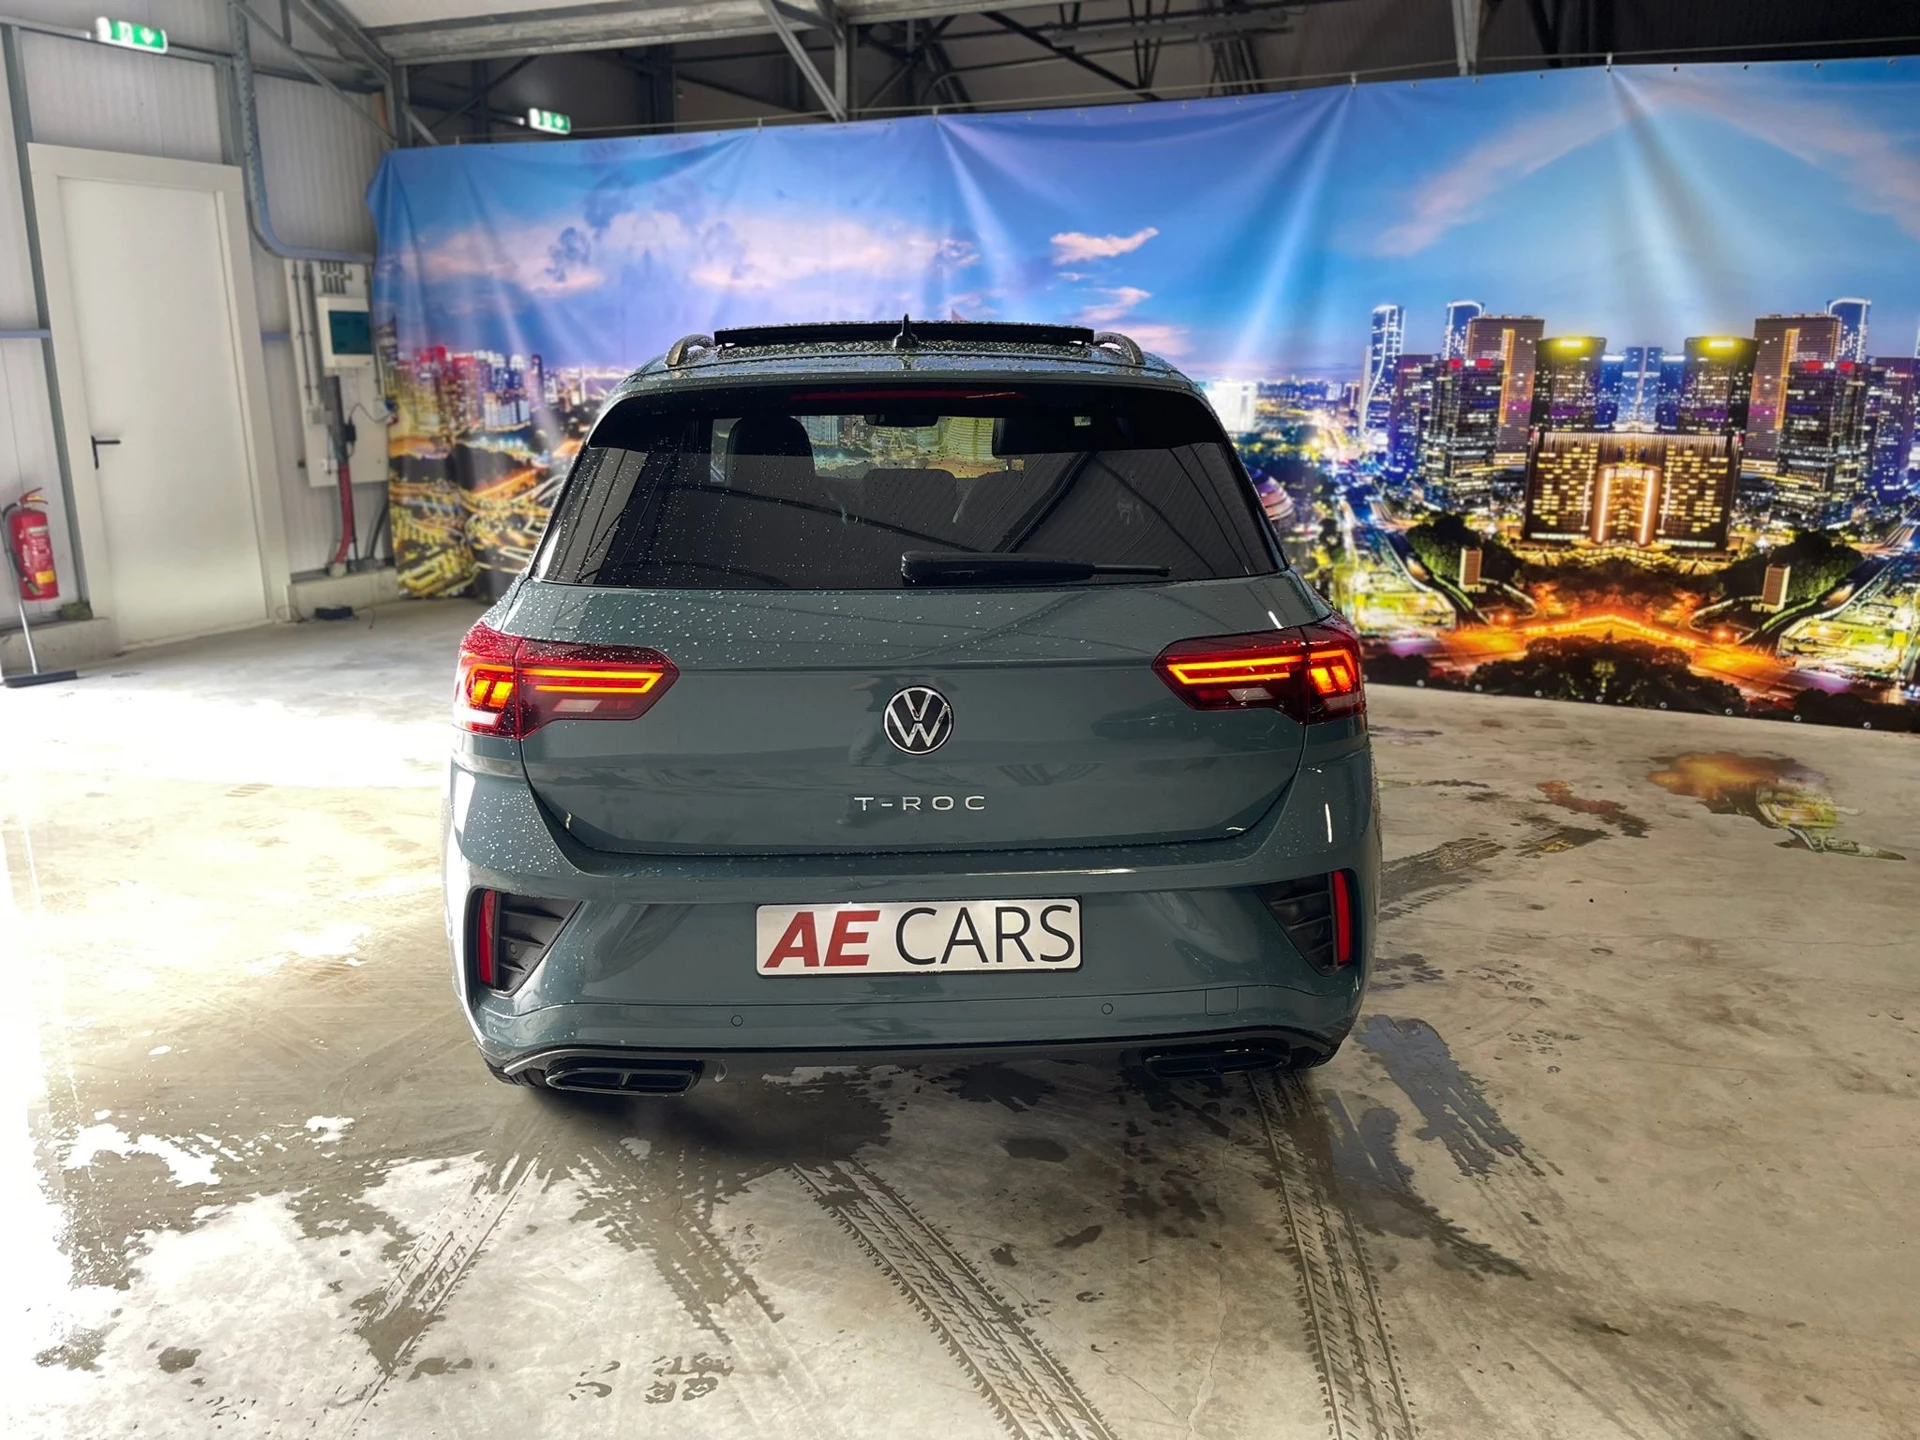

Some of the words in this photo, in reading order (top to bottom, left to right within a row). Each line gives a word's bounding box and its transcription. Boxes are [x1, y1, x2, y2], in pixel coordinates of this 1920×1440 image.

[885, 688, 953, 752] VW
[854, 796, 986, 811] T-ROC
[763, 911, 880, 968] AE
[896, 906, 1075, 964] CARS
